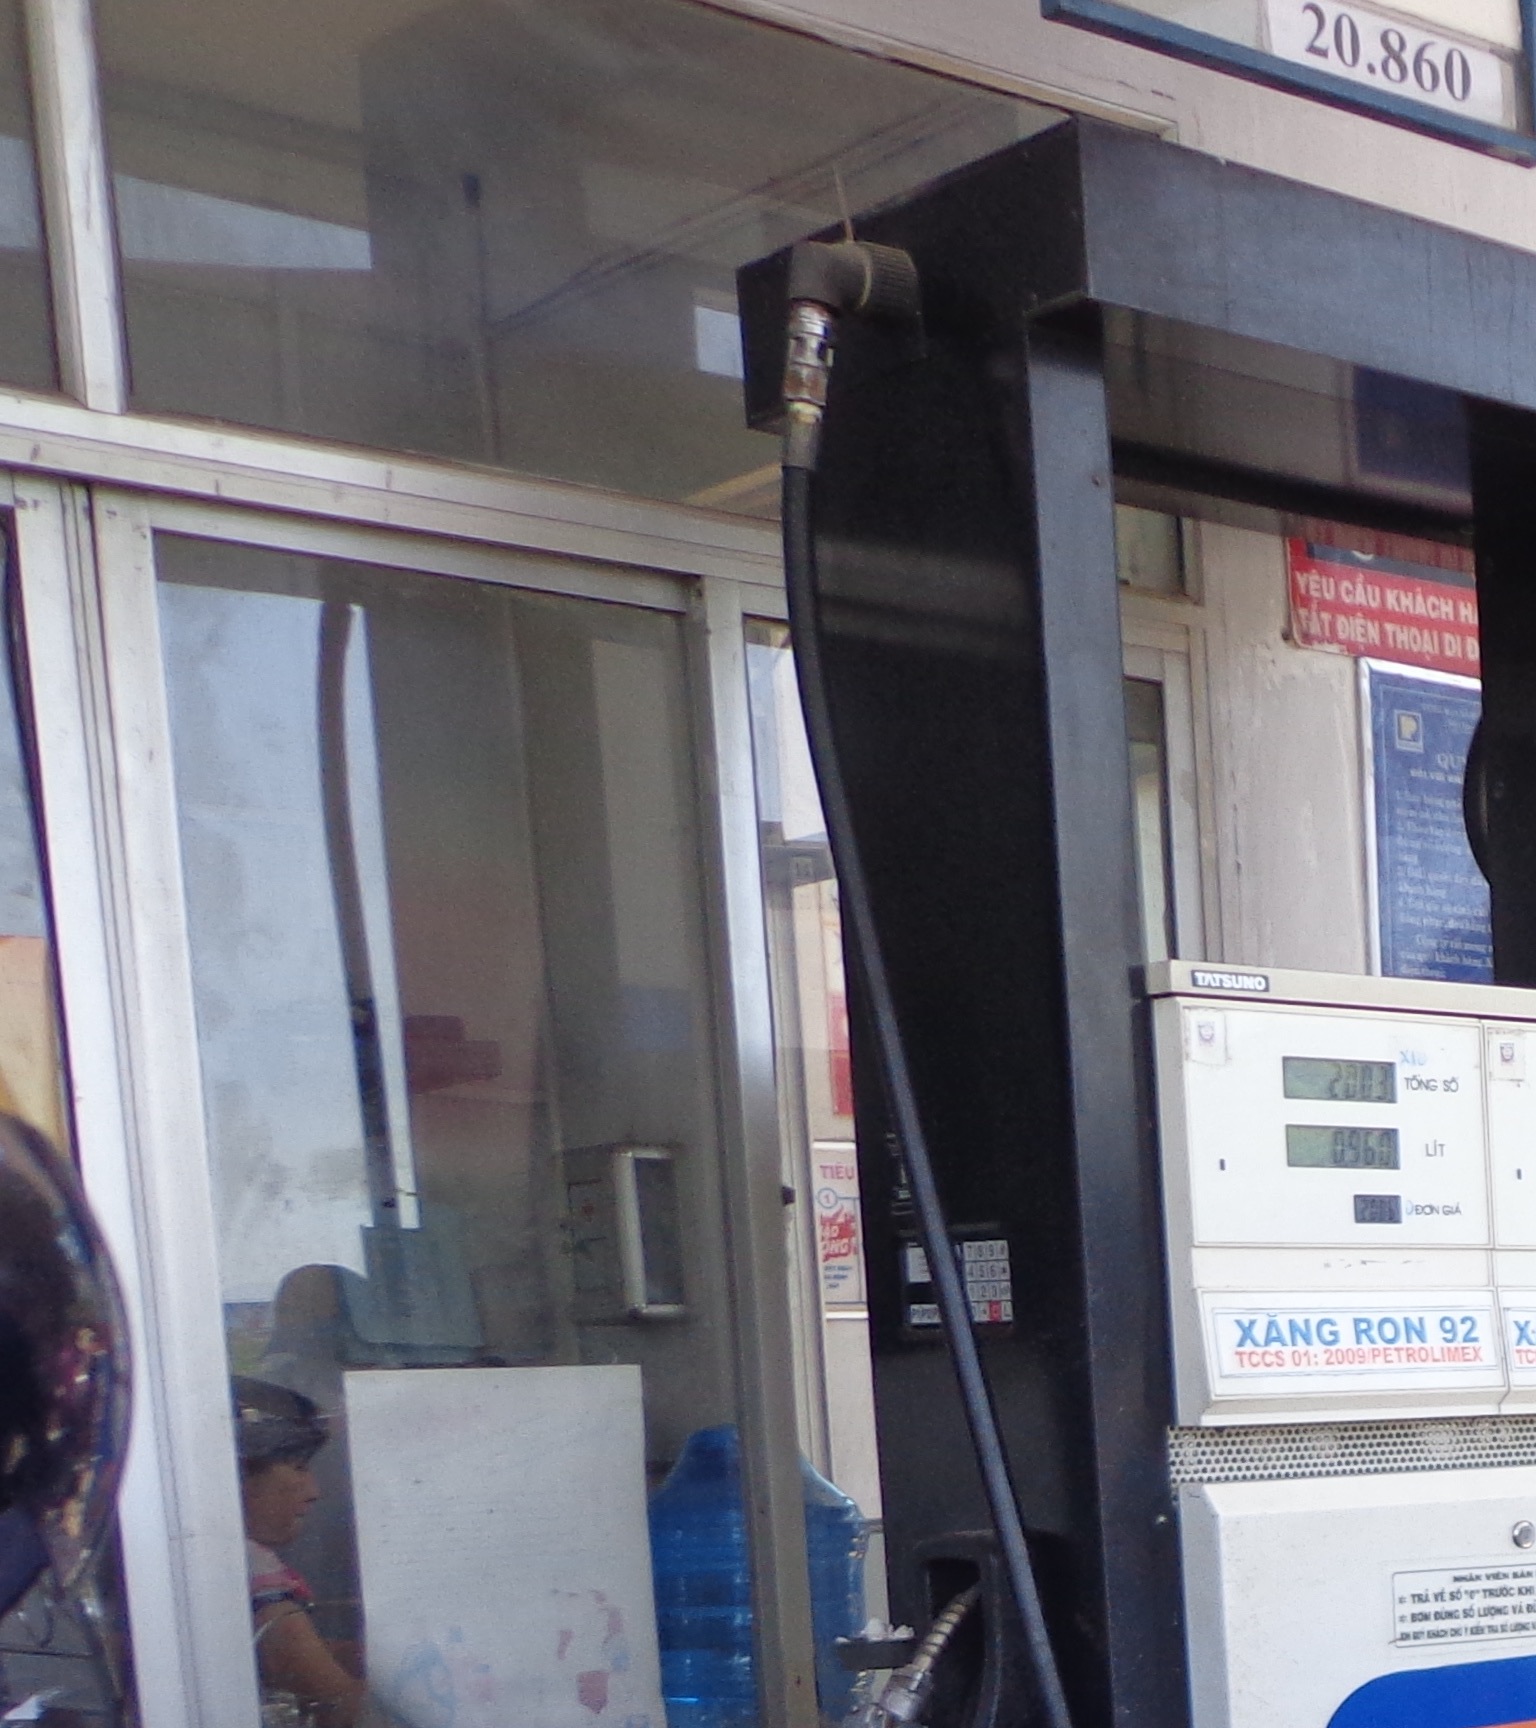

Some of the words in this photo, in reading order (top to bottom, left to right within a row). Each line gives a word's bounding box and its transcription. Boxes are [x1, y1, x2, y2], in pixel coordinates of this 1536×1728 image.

[1302, 1, 1472, 103] 20.860
[1296, 568, 1335, 598] YÊU
[1340, 573, 1381, 608] CẦU
[1387, 587, 1454, 621] KHÁCH
[1445, 631, 1461, 658] DI
[1194, 971, 1267, 991] TATSUNO
[1425, 1139, 1446, 1158] LÍT
[1442, 1202, 1462, 1216] GIÁ
[1234, 1313, 1341, 1348] XĂNG
[1353, 1316, 1428, 1345] RON
[1439, 1315, 1480, 1344] 92
[1235, 1350, 1285, 1368] TCCS
[1291, 1350, 1319, 1367] 01:
